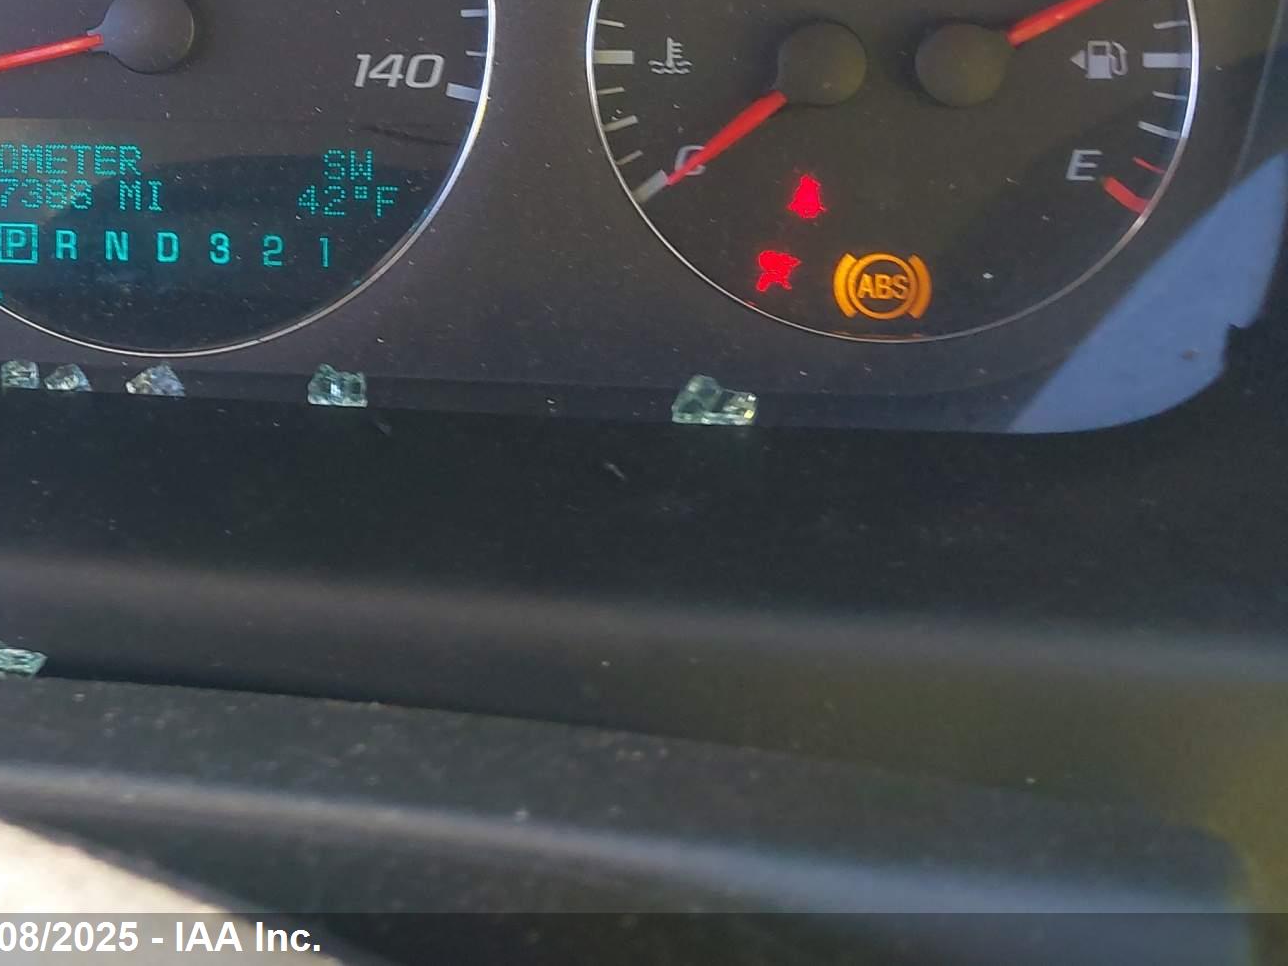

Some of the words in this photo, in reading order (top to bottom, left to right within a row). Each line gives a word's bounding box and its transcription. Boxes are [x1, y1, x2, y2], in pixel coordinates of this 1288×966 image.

[354, 54, 446, 90] 140
[323, 148, 374, 182] SW
[1065, 150, 1102, 181] E
[119, 179, 164, 212] MI
[7, 229, 27, 258] P
[55, 229, 78, 260] R
[105, 230, 130, 261] N
[157, 231, 179, 263] D
[209, 232, 231, 264] 3
[262, 235, 284, 267] 2
[319, 237, 331, 268] 1
[857, 272, 909, 300] ABS
